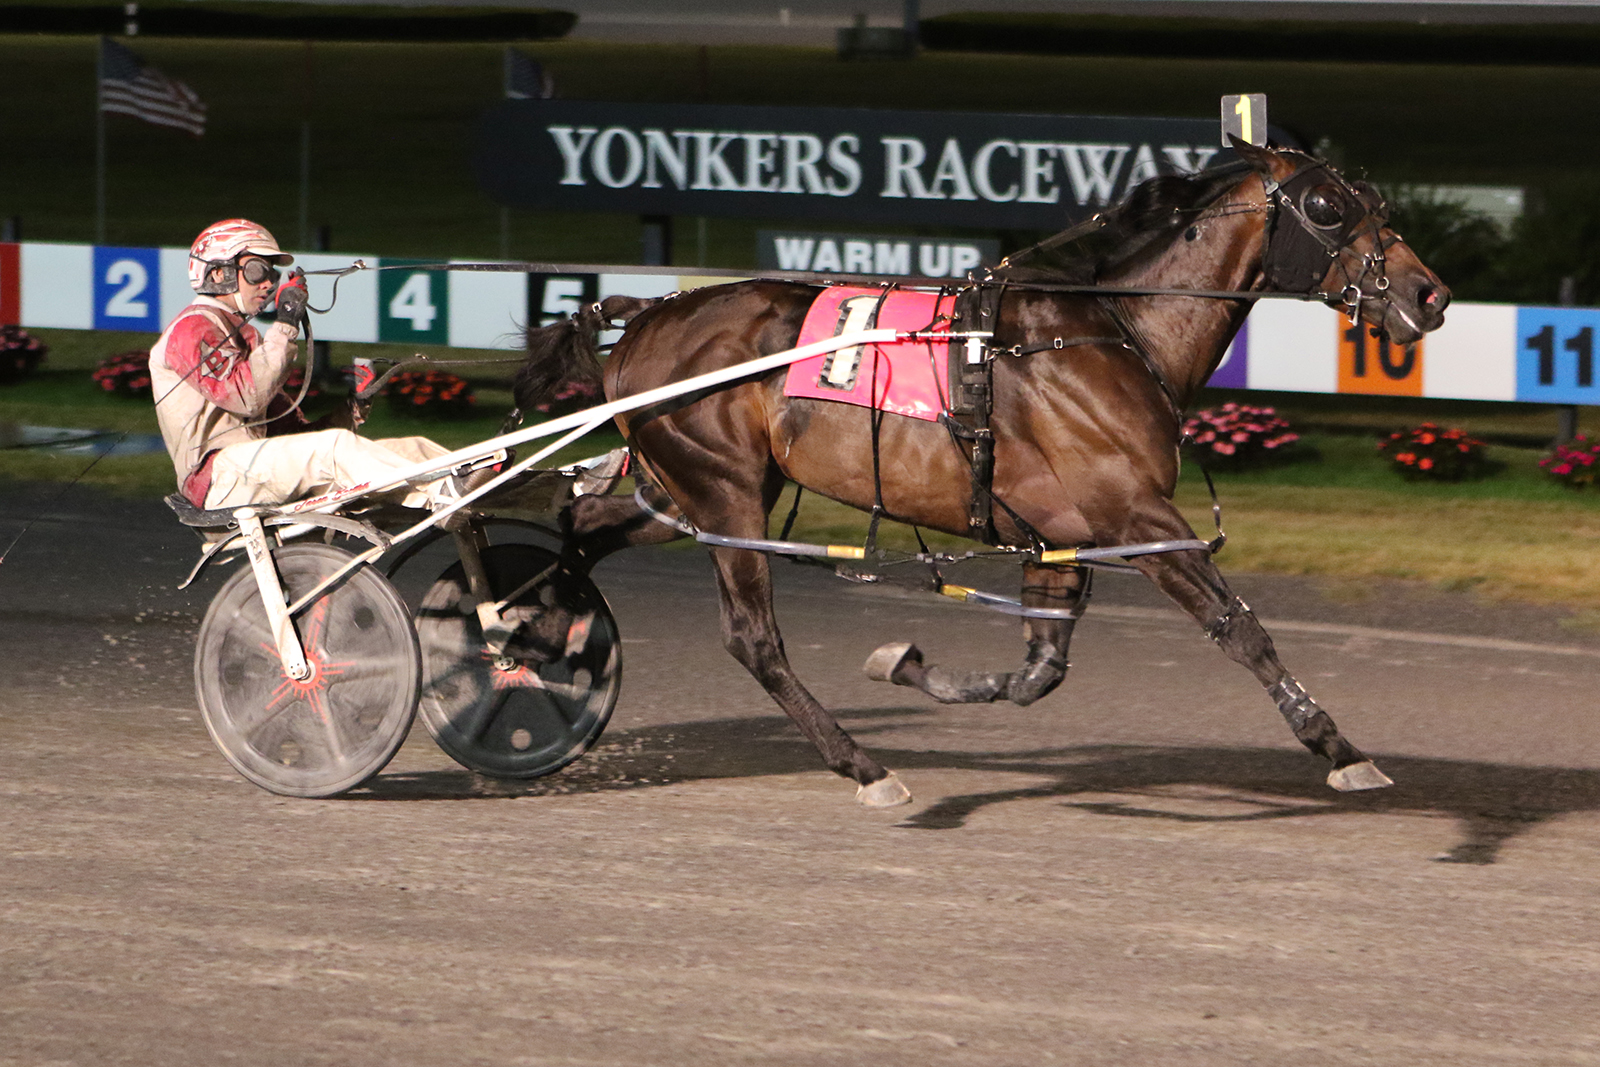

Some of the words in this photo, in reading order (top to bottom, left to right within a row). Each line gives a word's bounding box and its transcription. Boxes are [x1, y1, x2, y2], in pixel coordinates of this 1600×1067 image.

[1234, 94, 1253, 145] 1
[547, 126, 863, 197] YONKERS
[774, 237, 911, 275] WARM
[918, 244, 982, 278] UP
[104, 259, 149, 318] 2
[389, 273, 437, 331] 4
[541, 278, 585, 328] 5
[818, 295, 878, 391] 1
[1342, 323, 1417, 379] 10
[1526, 325, 1595, 388] 11
